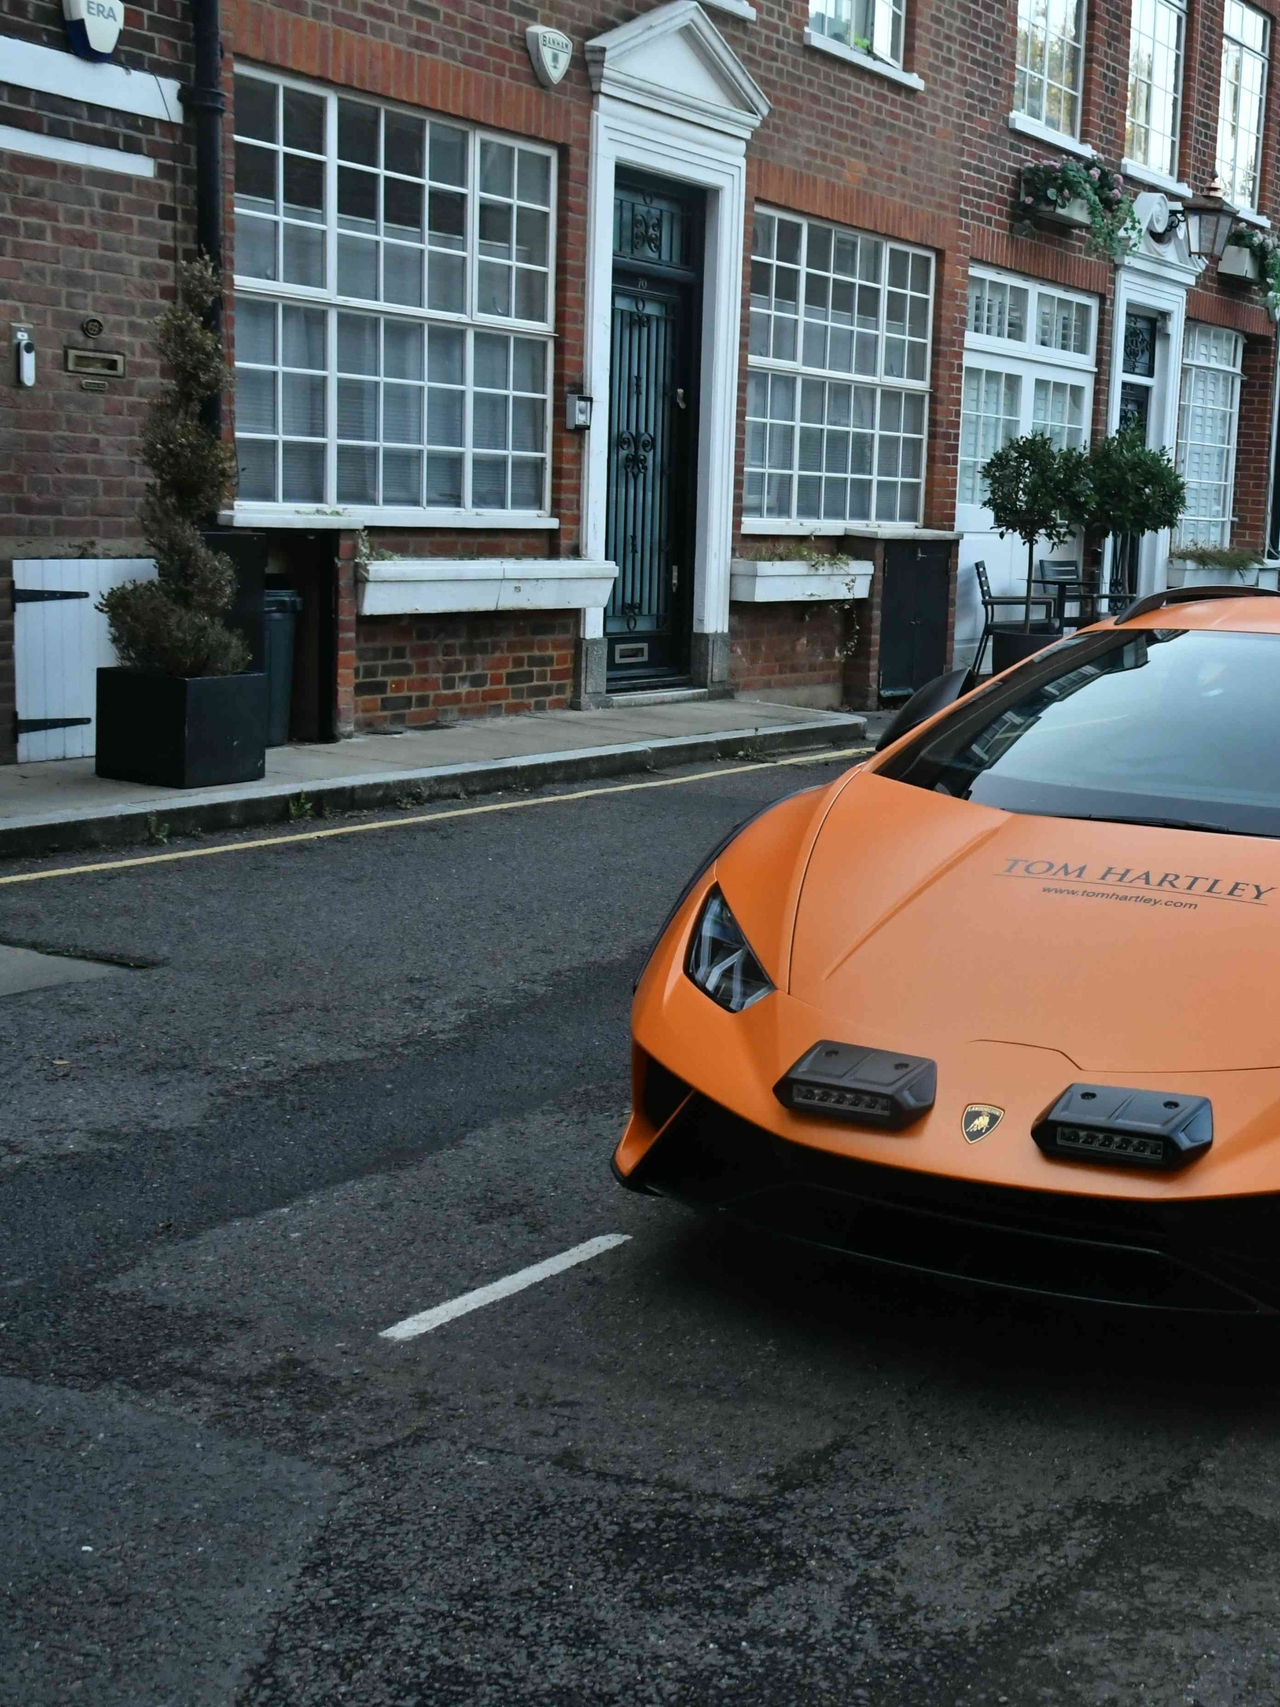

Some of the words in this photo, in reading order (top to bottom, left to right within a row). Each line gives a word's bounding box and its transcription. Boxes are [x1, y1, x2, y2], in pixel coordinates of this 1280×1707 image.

[86, 0, 118, 22] ERA
[1003, 858, 1088, 879] TOM
[1099, 866, 1279, 901] HARTLEY
[1041, 884, 1199, 911] www.tomhartley.com
